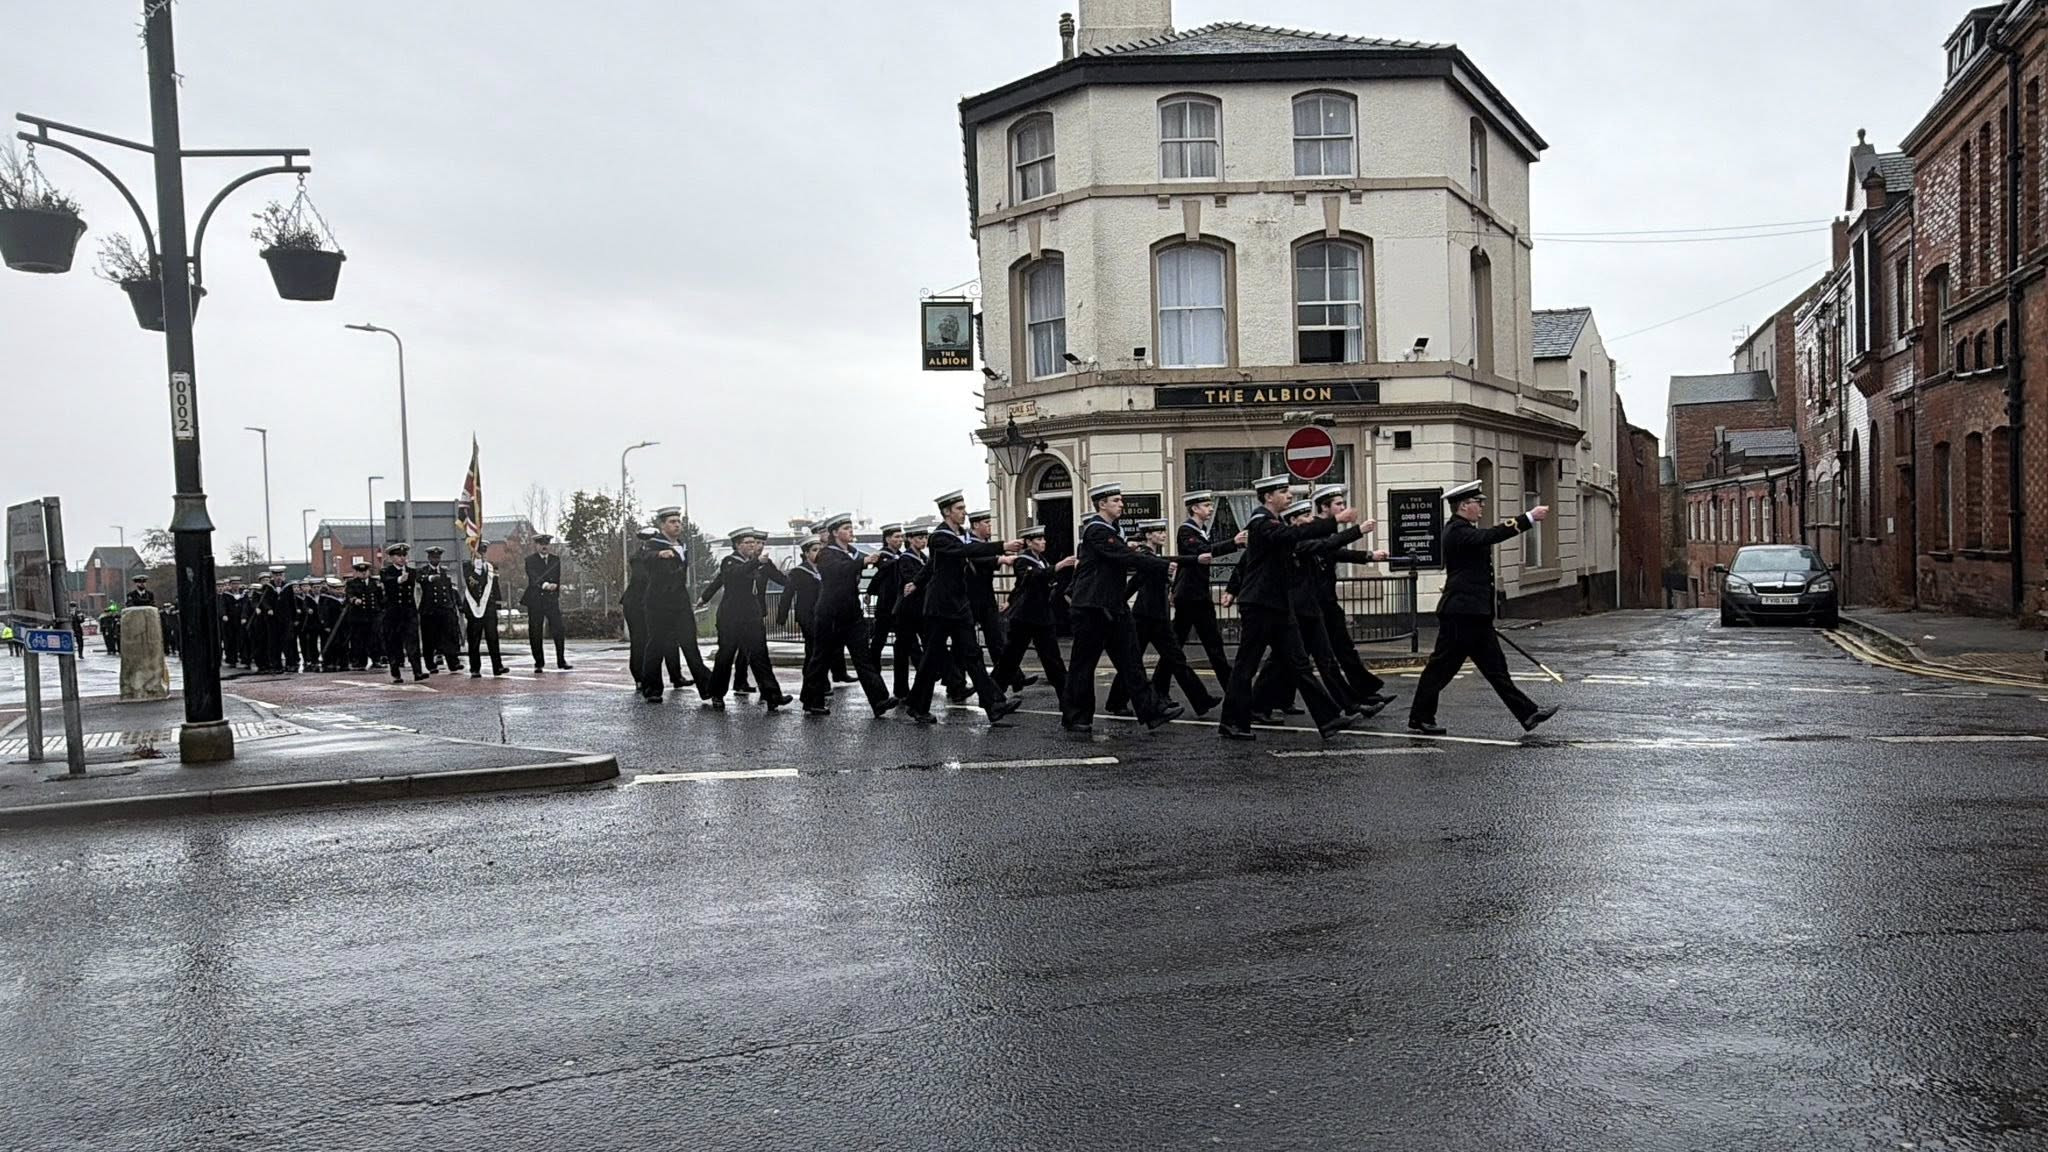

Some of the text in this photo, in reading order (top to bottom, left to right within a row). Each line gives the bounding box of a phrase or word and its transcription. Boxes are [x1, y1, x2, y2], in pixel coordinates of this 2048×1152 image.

[929, 357, 968, 366] ALBION
[1205, 387, 1332, 403] THE ALBION
[175, 380, 190, 431] 0002
